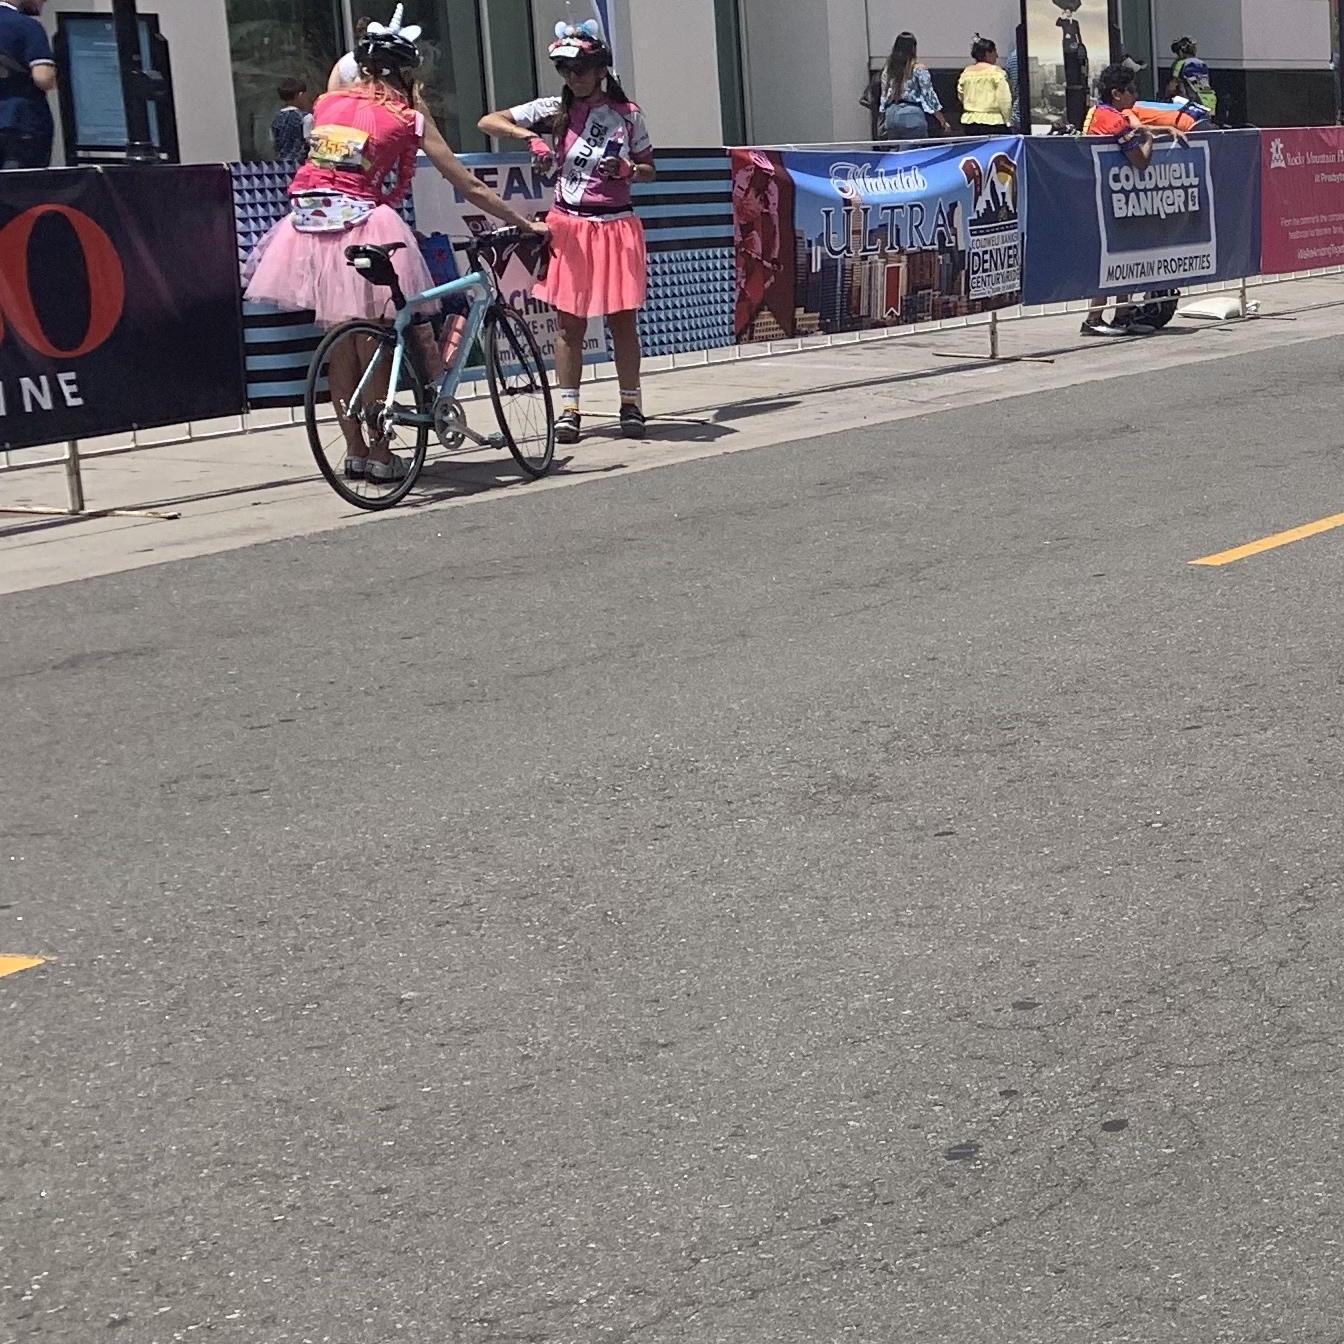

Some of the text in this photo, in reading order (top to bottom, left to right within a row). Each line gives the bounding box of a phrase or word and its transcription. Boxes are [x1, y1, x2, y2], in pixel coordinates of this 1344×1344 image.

[1108, 162, 1200, 192] COLDWELL
[1111, 188, 1186, 219] BANKER
[821, 199, 957, 259] ULTRA
[971, 244, 1019, 276] DENVER
[1106, 253, 1212, 282] MOUNTAIN PROPERTIES
